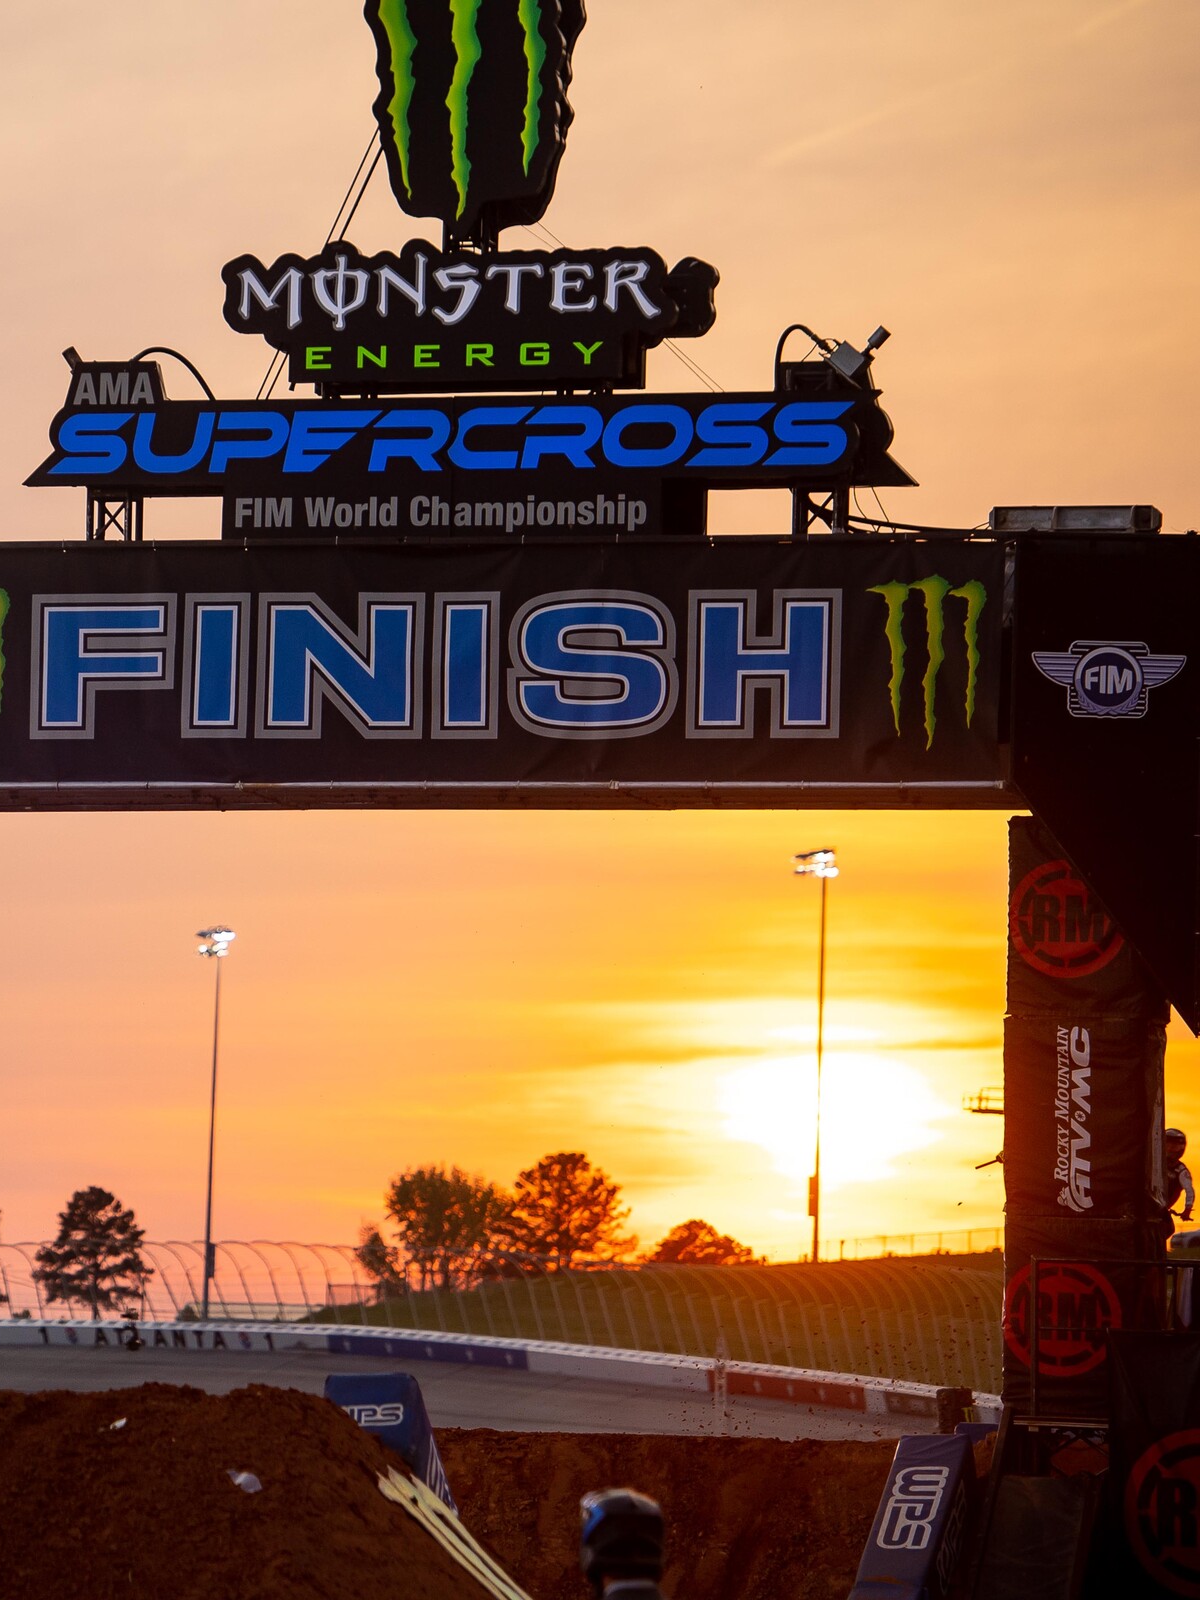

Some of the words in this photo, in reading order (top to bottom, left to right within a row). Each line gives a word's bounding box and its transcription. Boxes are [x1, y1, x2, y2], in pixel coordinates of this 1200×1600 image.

[304, 340, 604, 371] ENERGY
[73, 371, 155, 405] AMA
[47, 401, 855, 475] SUPERCROSS
[234, 497, 293, 528] FIM
[305, 496, 399, 527] World
[409, 493, 648, 531] Championship
[30, 588, 843, 741] FINISH
[1085, 663, 1132, 695] FIM
[1054, 1025, 1070, 1122] MOUNTAIN
[1054, 1123, 1070, 1184] ROCKY
[877, 1466, 950, 1550] WPS
